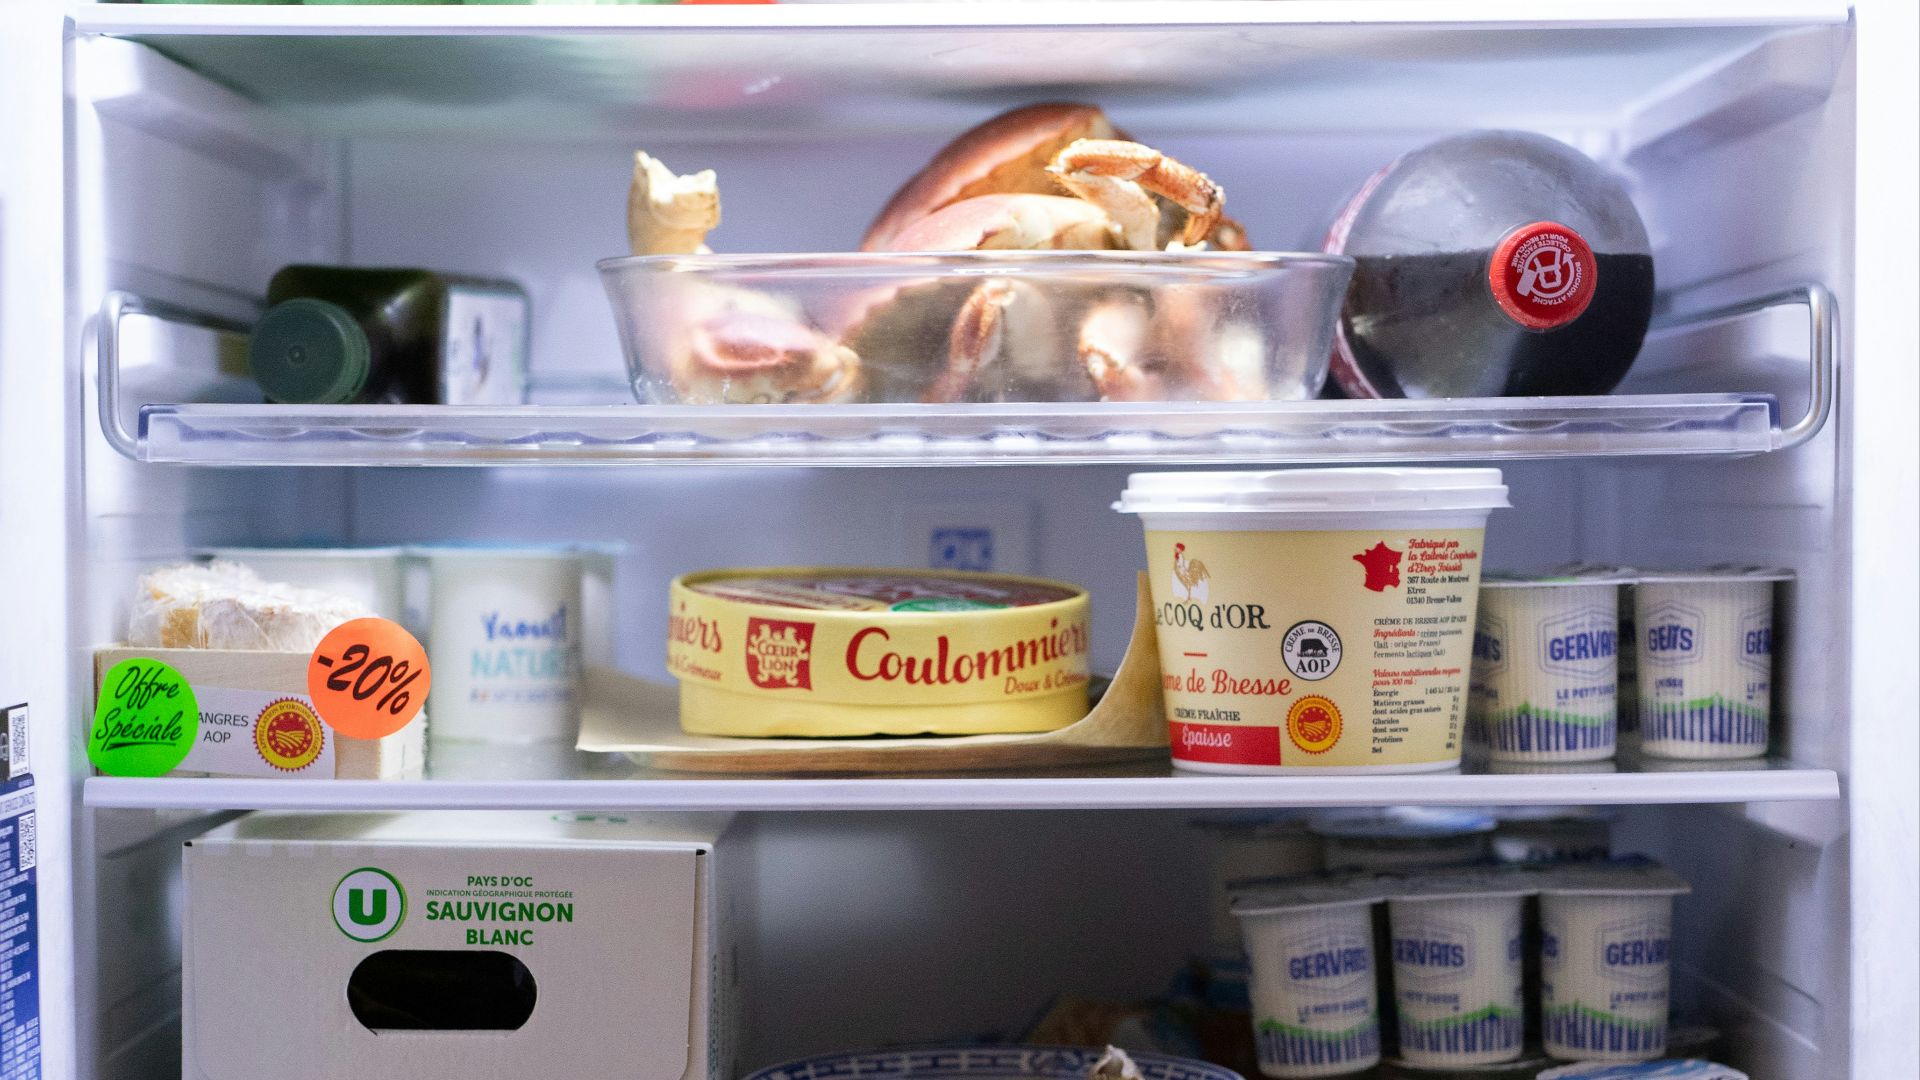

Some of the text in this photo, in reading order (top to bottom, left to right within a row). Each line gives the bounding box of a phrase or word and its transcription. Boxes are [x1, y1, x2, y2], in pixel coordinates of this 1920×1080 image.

[1511, 233, 1570, 268] POUR LE RECYCLAGE
[1537, 239, 1572, 253] COLLECTE
[1566, 261, 1583, 298] BOUCHON
[1407, 576, 1419, 584] 367
[1420, 576, 1440, 584] Route
[1406, 596, 1425, 604] 01340
[1164, 602, 1204, 631] COQ
[1210, 604, 1271, 629] d'OR
[1374, 617, 1401, 625] CRÈME
[1402, 617, 1413, 625] DE
[1414, 616, 1438, 625] BRESSE
[1316, 626, 1339, 654] BRESSE
[761, 656, 795, 672] LION
[1295, 658, 1331, 673] AOP
[317, 643, 422, 715] -20%
[1003, 676, 1038, 695] Doux
[1042, 674, 1052, 689] &
[1186, 667, 1206, 693] de
[1211, 668, 1292, 696] Bresse
[115, 666, 180, 710] Offre
[198, 711, 249, 727] ANGRES
[1198, 707, 1241, 722] FRAÎCHE
[1372, 717, 1400, 725] Glucides
[96, 707, 184, 752] Spéciale
[203, 730, 231, 743] AOP
[467, 876, 533, 887] PAYS D'OC
[426, 889, 573, 899] INDICATION GÉOGRAPHIQUE PROTÉGÉE
[349, 889, 387, 925] U
[426, 901, 574, 923] SAUVIGNON
[466, 929, 534, 945] BLANC
[1392, 938, 1465, 967] ERVAIS
